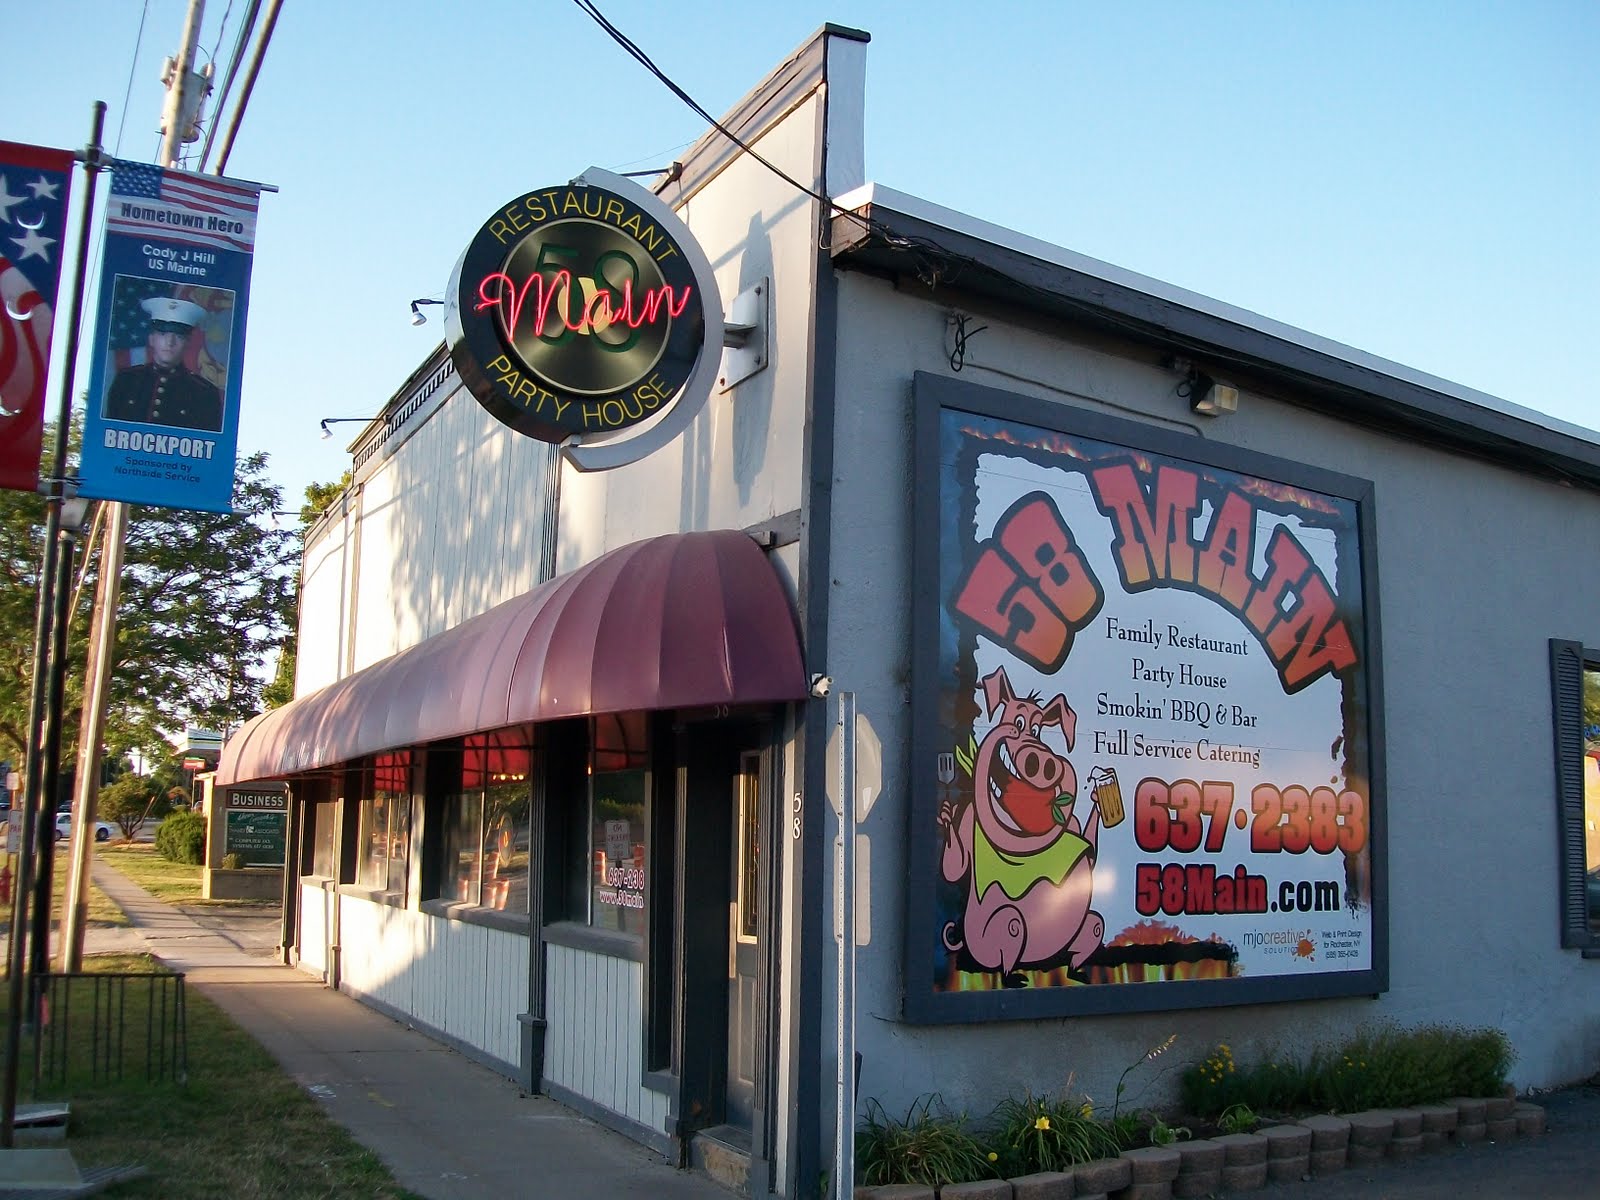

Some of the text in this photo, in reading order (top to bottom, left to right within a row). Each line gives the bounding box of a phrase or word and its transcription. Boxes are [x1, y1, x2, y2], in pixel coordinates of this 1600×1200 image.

[121, 202, 244, 234] Hometown Hero
[489, 191, 678, 262] RESTAURANT
[142, 244, 215, 265] Cody J Hill
[148, 258, 207, 276] US Marine
[473, 270, 691, 343] Main
[486, 354, 674, 427] PARTY HOUSE
[104, 428, 216, 460] BROCKPORT
[114, 465, 201, 483] Northside Service
[125, 456, 193, 473] Sponsored by
[952, 455, 1360, 695] 58 MAIN
[1105, 617, 1249, 656] Family Restaurant
[1131, 658, 1228, 689] Party House
[1096, 692, 1258, 728] Smokin' BBQ & Bar
[1093, 729, 1261, 769] Full Service Catering
[232, 792, 284, 807] BUSINESS
[1134, 862, 1340, 917] 58Main.com
